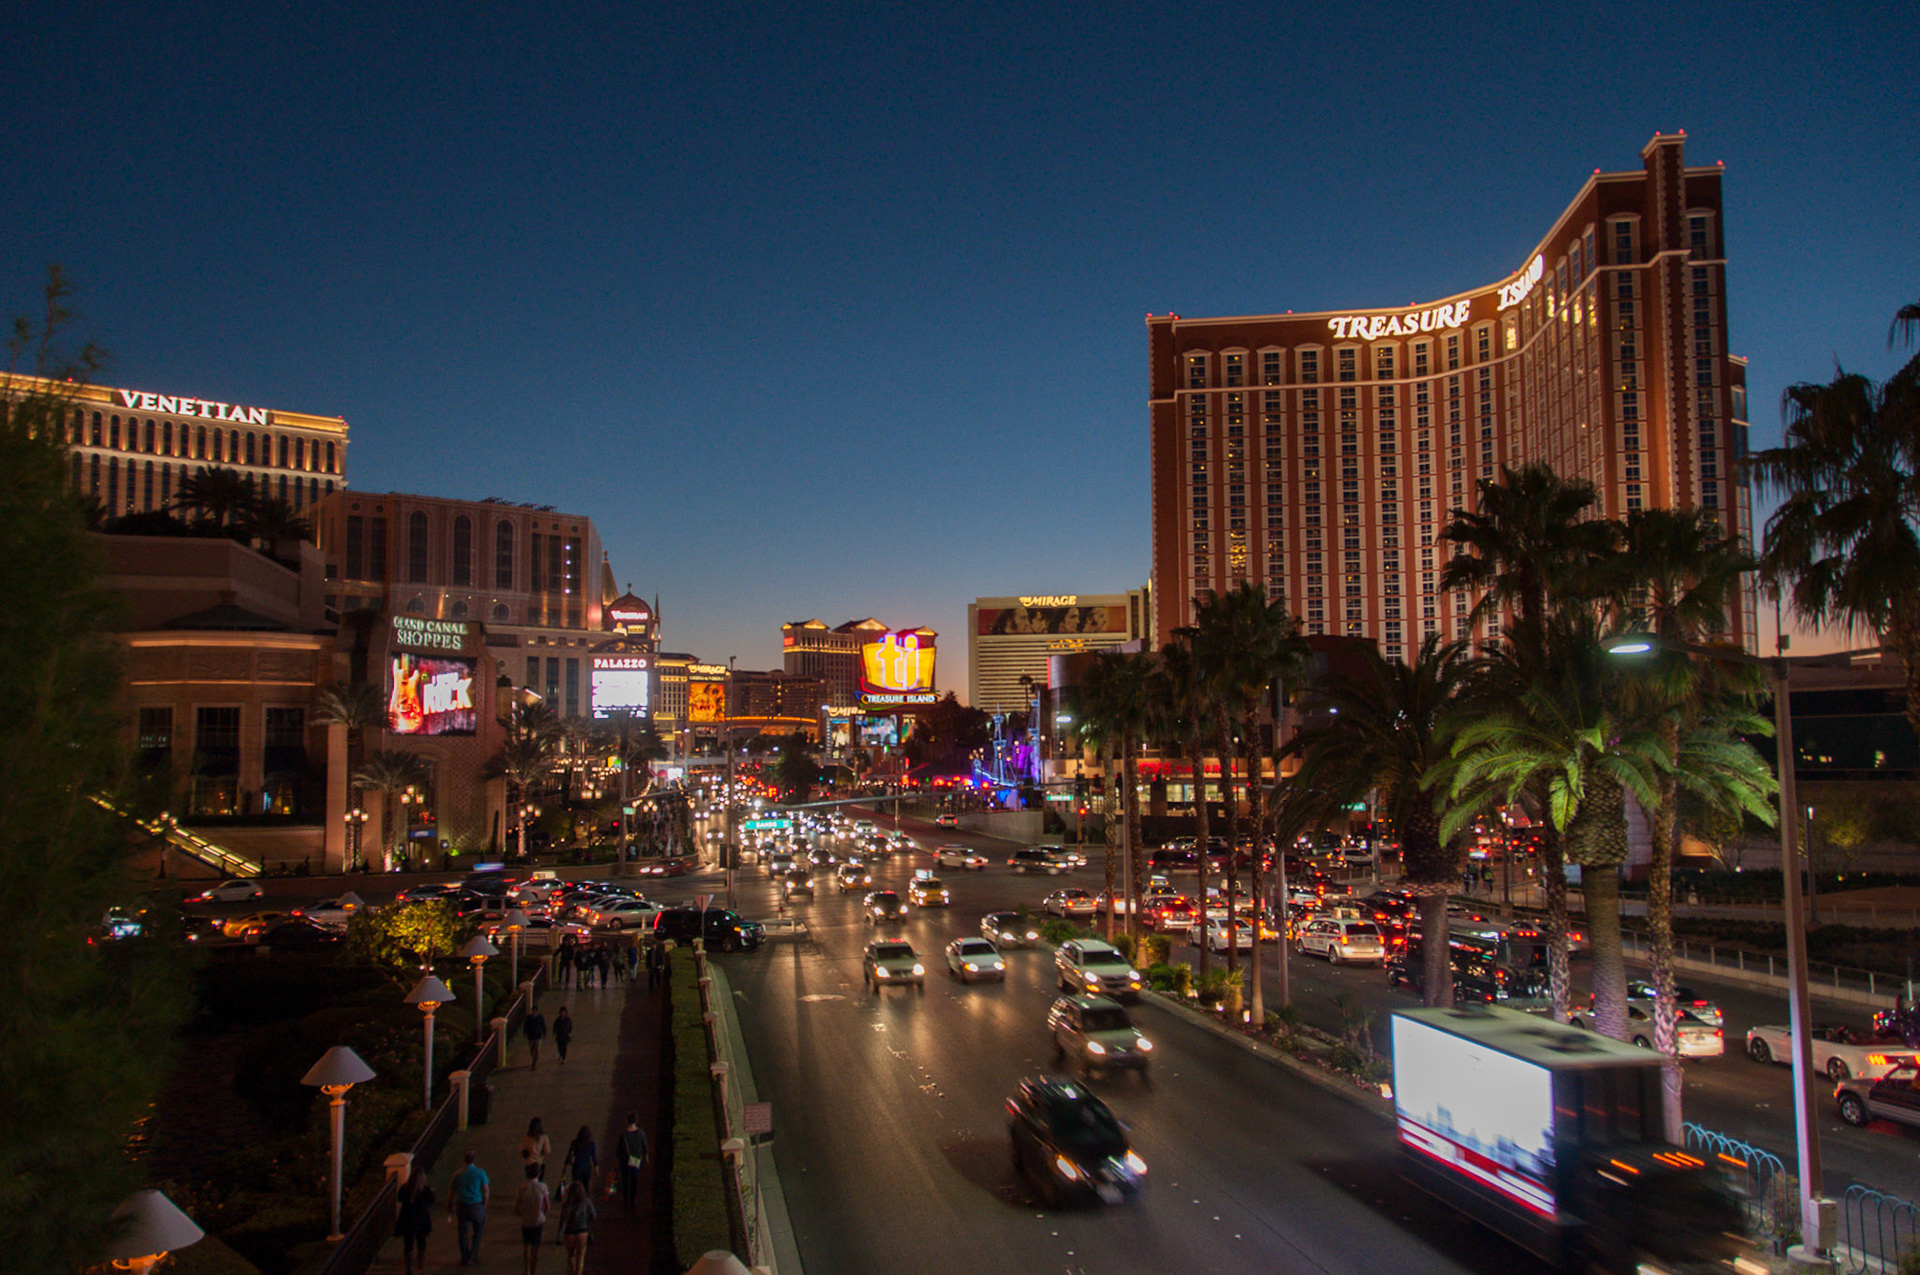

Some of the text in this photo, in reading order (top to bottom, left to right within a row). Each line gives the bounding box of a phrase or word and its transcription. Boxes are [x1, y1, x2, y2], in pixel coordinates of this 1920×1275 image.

[1328, 299, 1471, 341] TREASURE
[119, 388, 269, 426] VENETIAN
[1031, 595, 1077, 607] MIRAGE
[426, 620, 468, 634] CANAL
[397, 629, 463, 650] SHOPPES
[593, 658, 647, 669] PALAZZO
[876, 633, 919, 690] ti
[867, 694, 936, 703] TREASURE ISLAND
[1139, 762, 1172, 775] CVS
